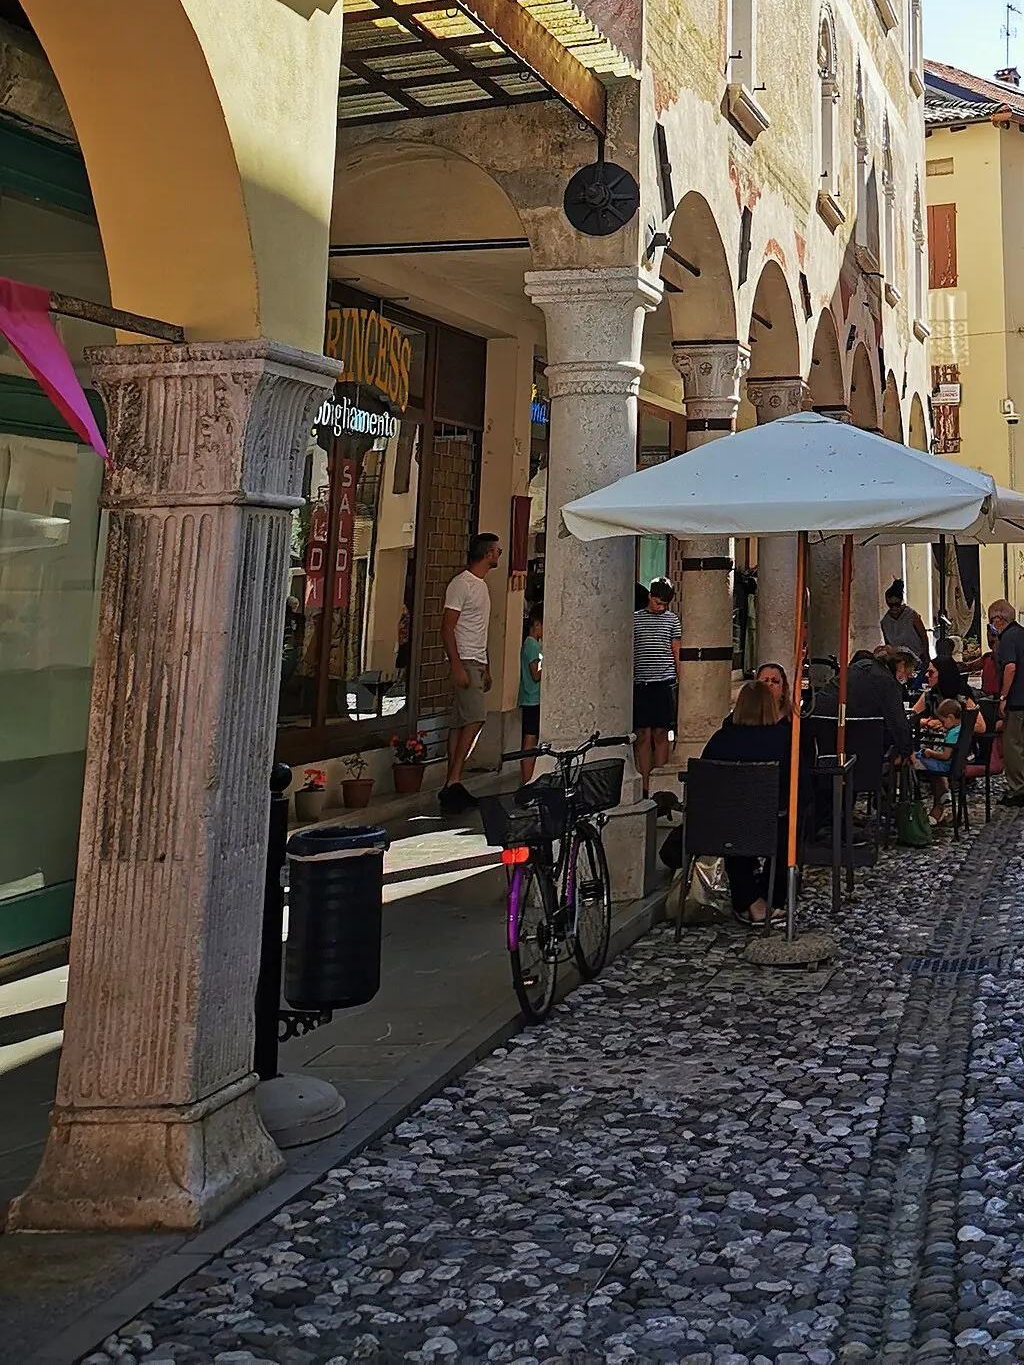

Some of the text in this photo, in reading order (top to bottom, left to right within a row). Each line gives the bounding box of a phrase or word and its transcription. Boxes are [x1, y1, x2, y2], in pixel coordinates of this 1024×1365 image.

[326, 307, 412, 414] RINCESS
[313, 395, 399, 438] bigliamento
[310, 491, 328, 600] ALDI
[335, 465, 353, 600] SALDI
